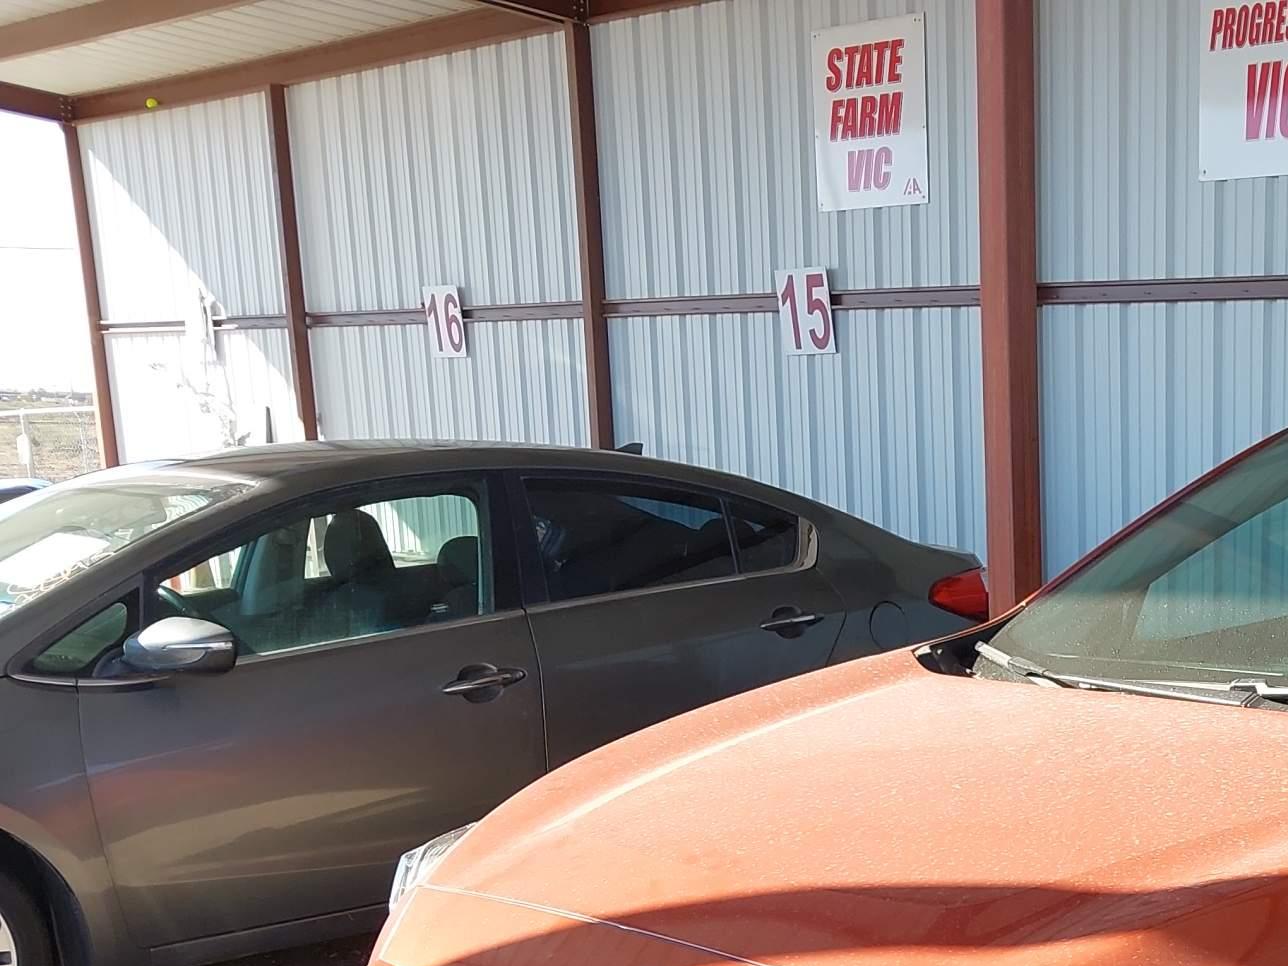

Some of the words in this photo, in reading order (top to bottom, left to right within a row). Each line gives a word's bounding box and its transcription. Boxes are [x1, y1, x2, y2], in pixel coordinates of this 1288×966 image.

[825, 38, 905, 93] STATE
[829, 91, 904, 142] FARM
[847, 146, 893, 193] VIC
[426, 292, 464, 354] 16
[780, 272, 831, 351] 15
